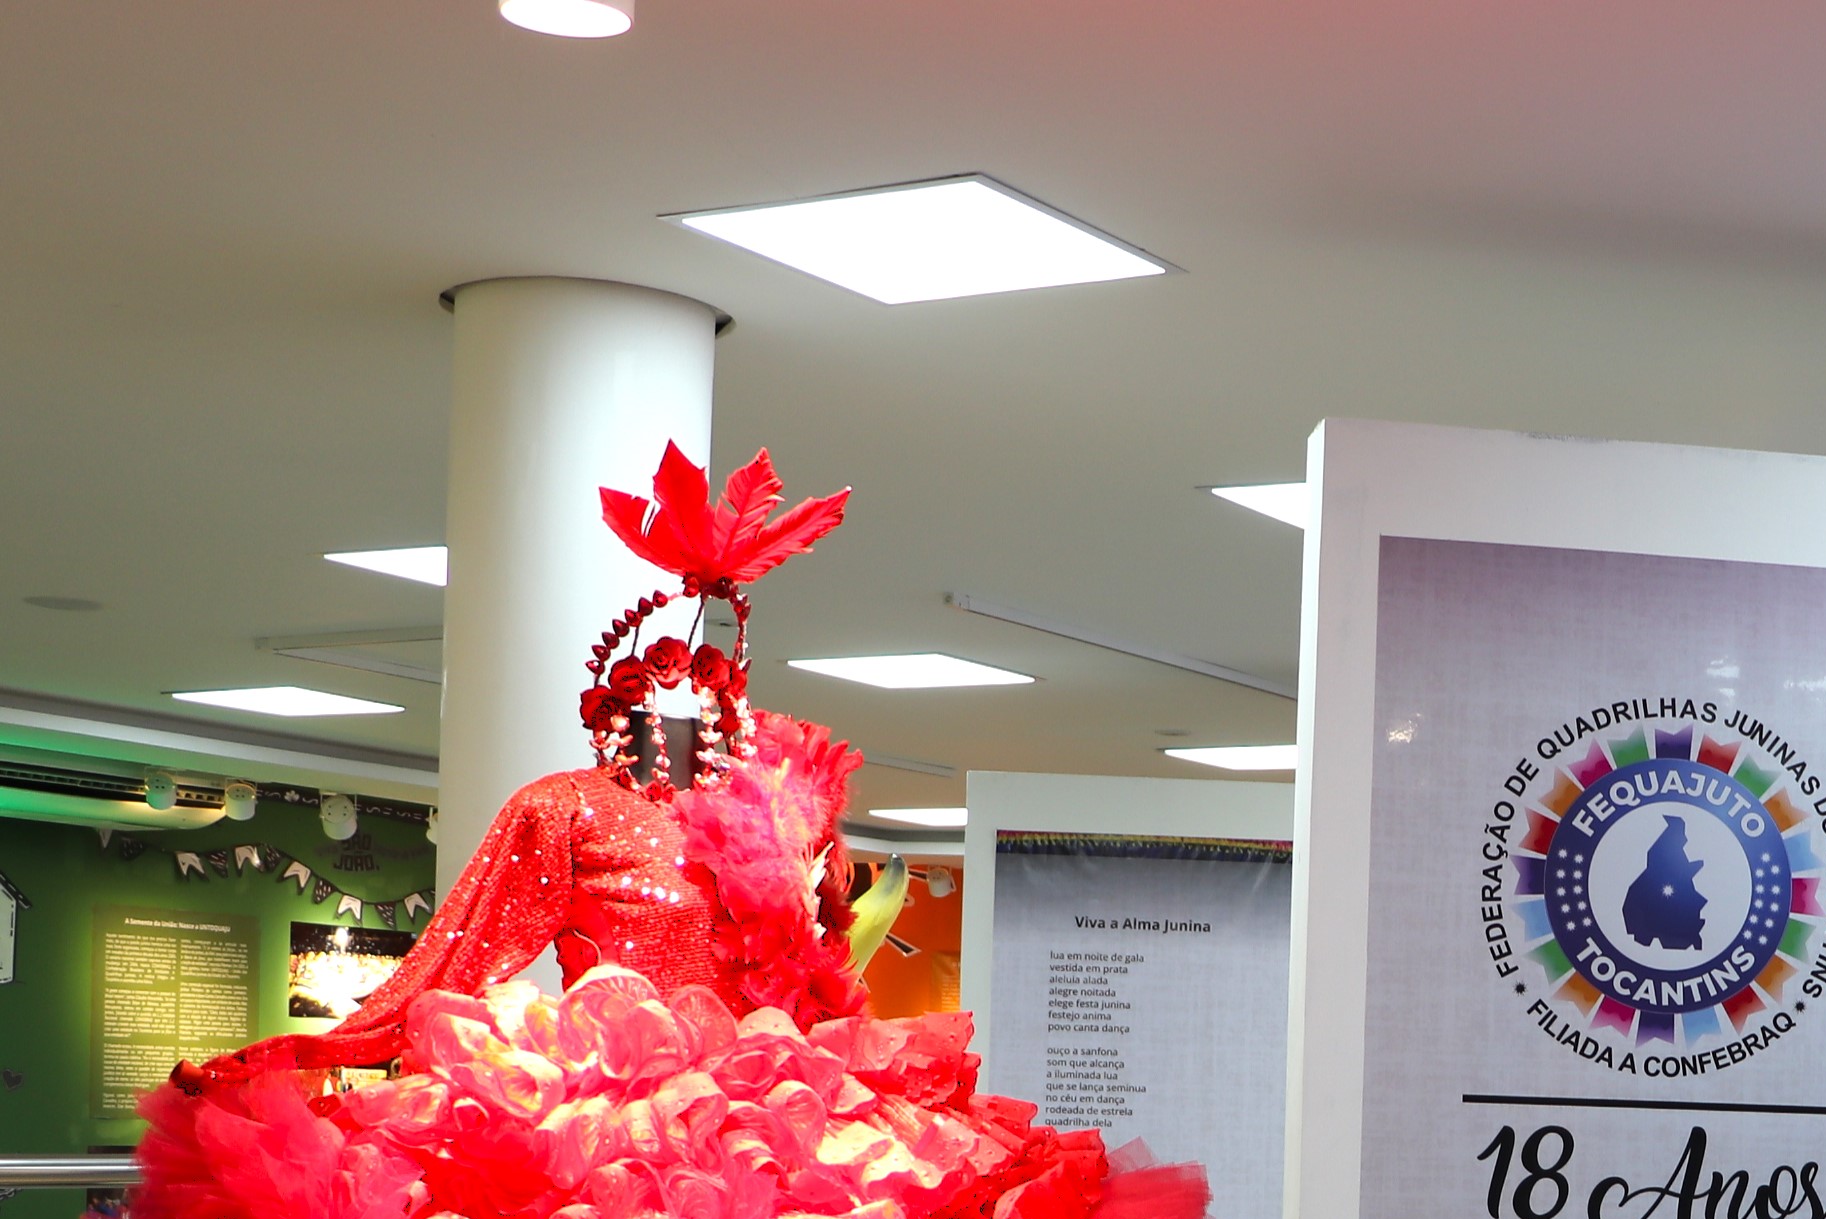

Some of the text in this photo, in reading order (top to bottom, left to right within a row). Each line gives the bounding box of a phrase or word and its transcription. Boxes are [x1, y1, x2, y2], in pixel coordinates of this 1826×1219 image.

[1571, 769, 1765, 838] FEQUAJUTO
[1481, 800, 1519, 978] FEDERAÇÃO
[1504, 758, 1539, 797] DE
[1536, 697, 1718, 760] QUADRILHAS
[1724, 709, 1821, 796] JUNINAS
[1074, 915, 1211, 935] Viva a Alma Junina
[1050, 950, 1145, 965] lua em noite de gala
[1049, 962, 1128, 976] vestida em prata
[1576, 936, 1756, 1007] TOCANTINS
[1049, 974, 1109, 986] aleluia alada
[1048, 986, 1116, 998] alegre noitada
[1048, 998, 1131, 1011] elege festa junina
[1048, 1009, 1112, 1022] festejo anima
[1047, 1023, 1130, 1036] povo canta dança
[1526, 998, 1797, 1078] FILIADA A CONFEBRAQ
[1046, 1046, 1119, 1057] ouço a sanfona
[1046, 1058, 1125, 1071] som que alcança
[1046, 1069, 1118, 1081] a iluminada lua
[1045, 1081, 1147, 1094] que se lança seminua
[1045, 1093, 1125, 1107] no céu em dança
[1045, 1105, 1133, 1117] rodeada de estrela
[1045, 1117, 1113, 1128] quadrilha dela
